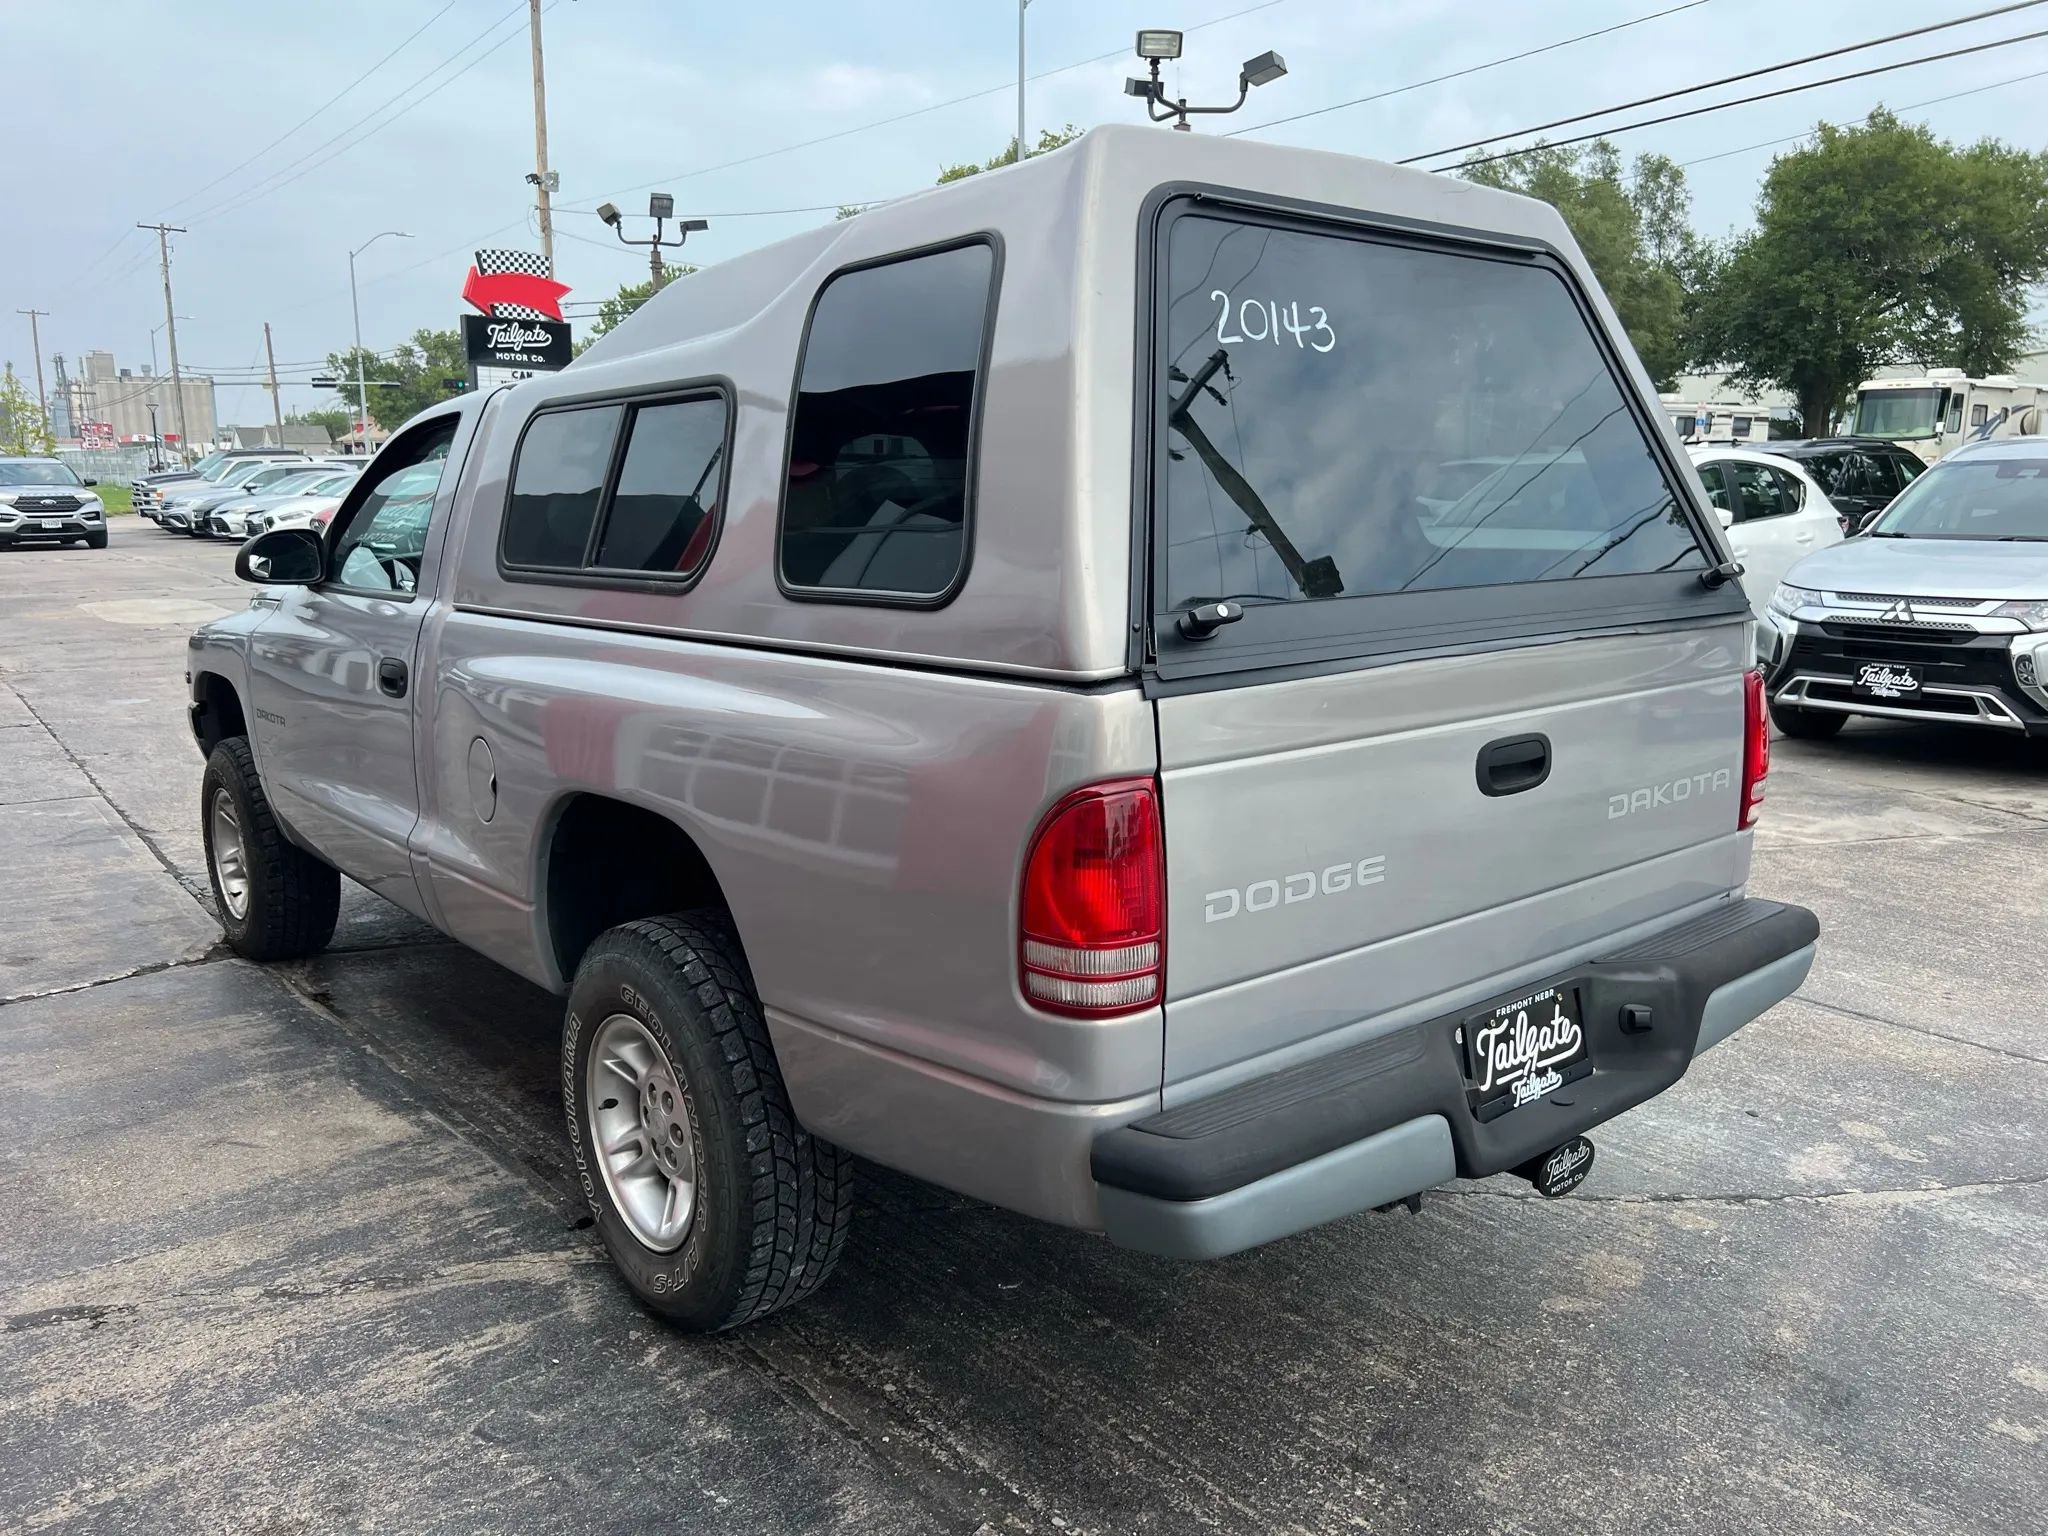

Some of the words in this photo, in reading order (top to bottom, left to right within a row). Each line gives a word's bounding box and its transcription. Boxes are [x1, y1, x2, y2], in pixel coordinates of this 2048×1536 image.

[487, 321, 553, 351] Tailgate
[1210, 289, 1336, 352] 20143
[496, 352, 529, 362] MOTOR
[531, 355, 546, 363] CO.
[1856, 666, 1919, 691] Tailgate
[1607, 768, 1731, 820] DAKOTA
[1204, 855, 1386, 924] DODGE
[1496, 997, 1534, 1018] FREMONT
[1534, 988, 1555, 1003] NEBR
[1476, 1003, 1582, 1091] Tailgate
[1512, 1067, 1562, 1108] Tailgate
[563, 1012, 603, 1224] YOKOHAMA
[1546, 1141, 1590, 1186] Tailgate
[1551, 1176, 1573, 1195] MOTOR
[1574, 1173, 1585, 1185] CO.
